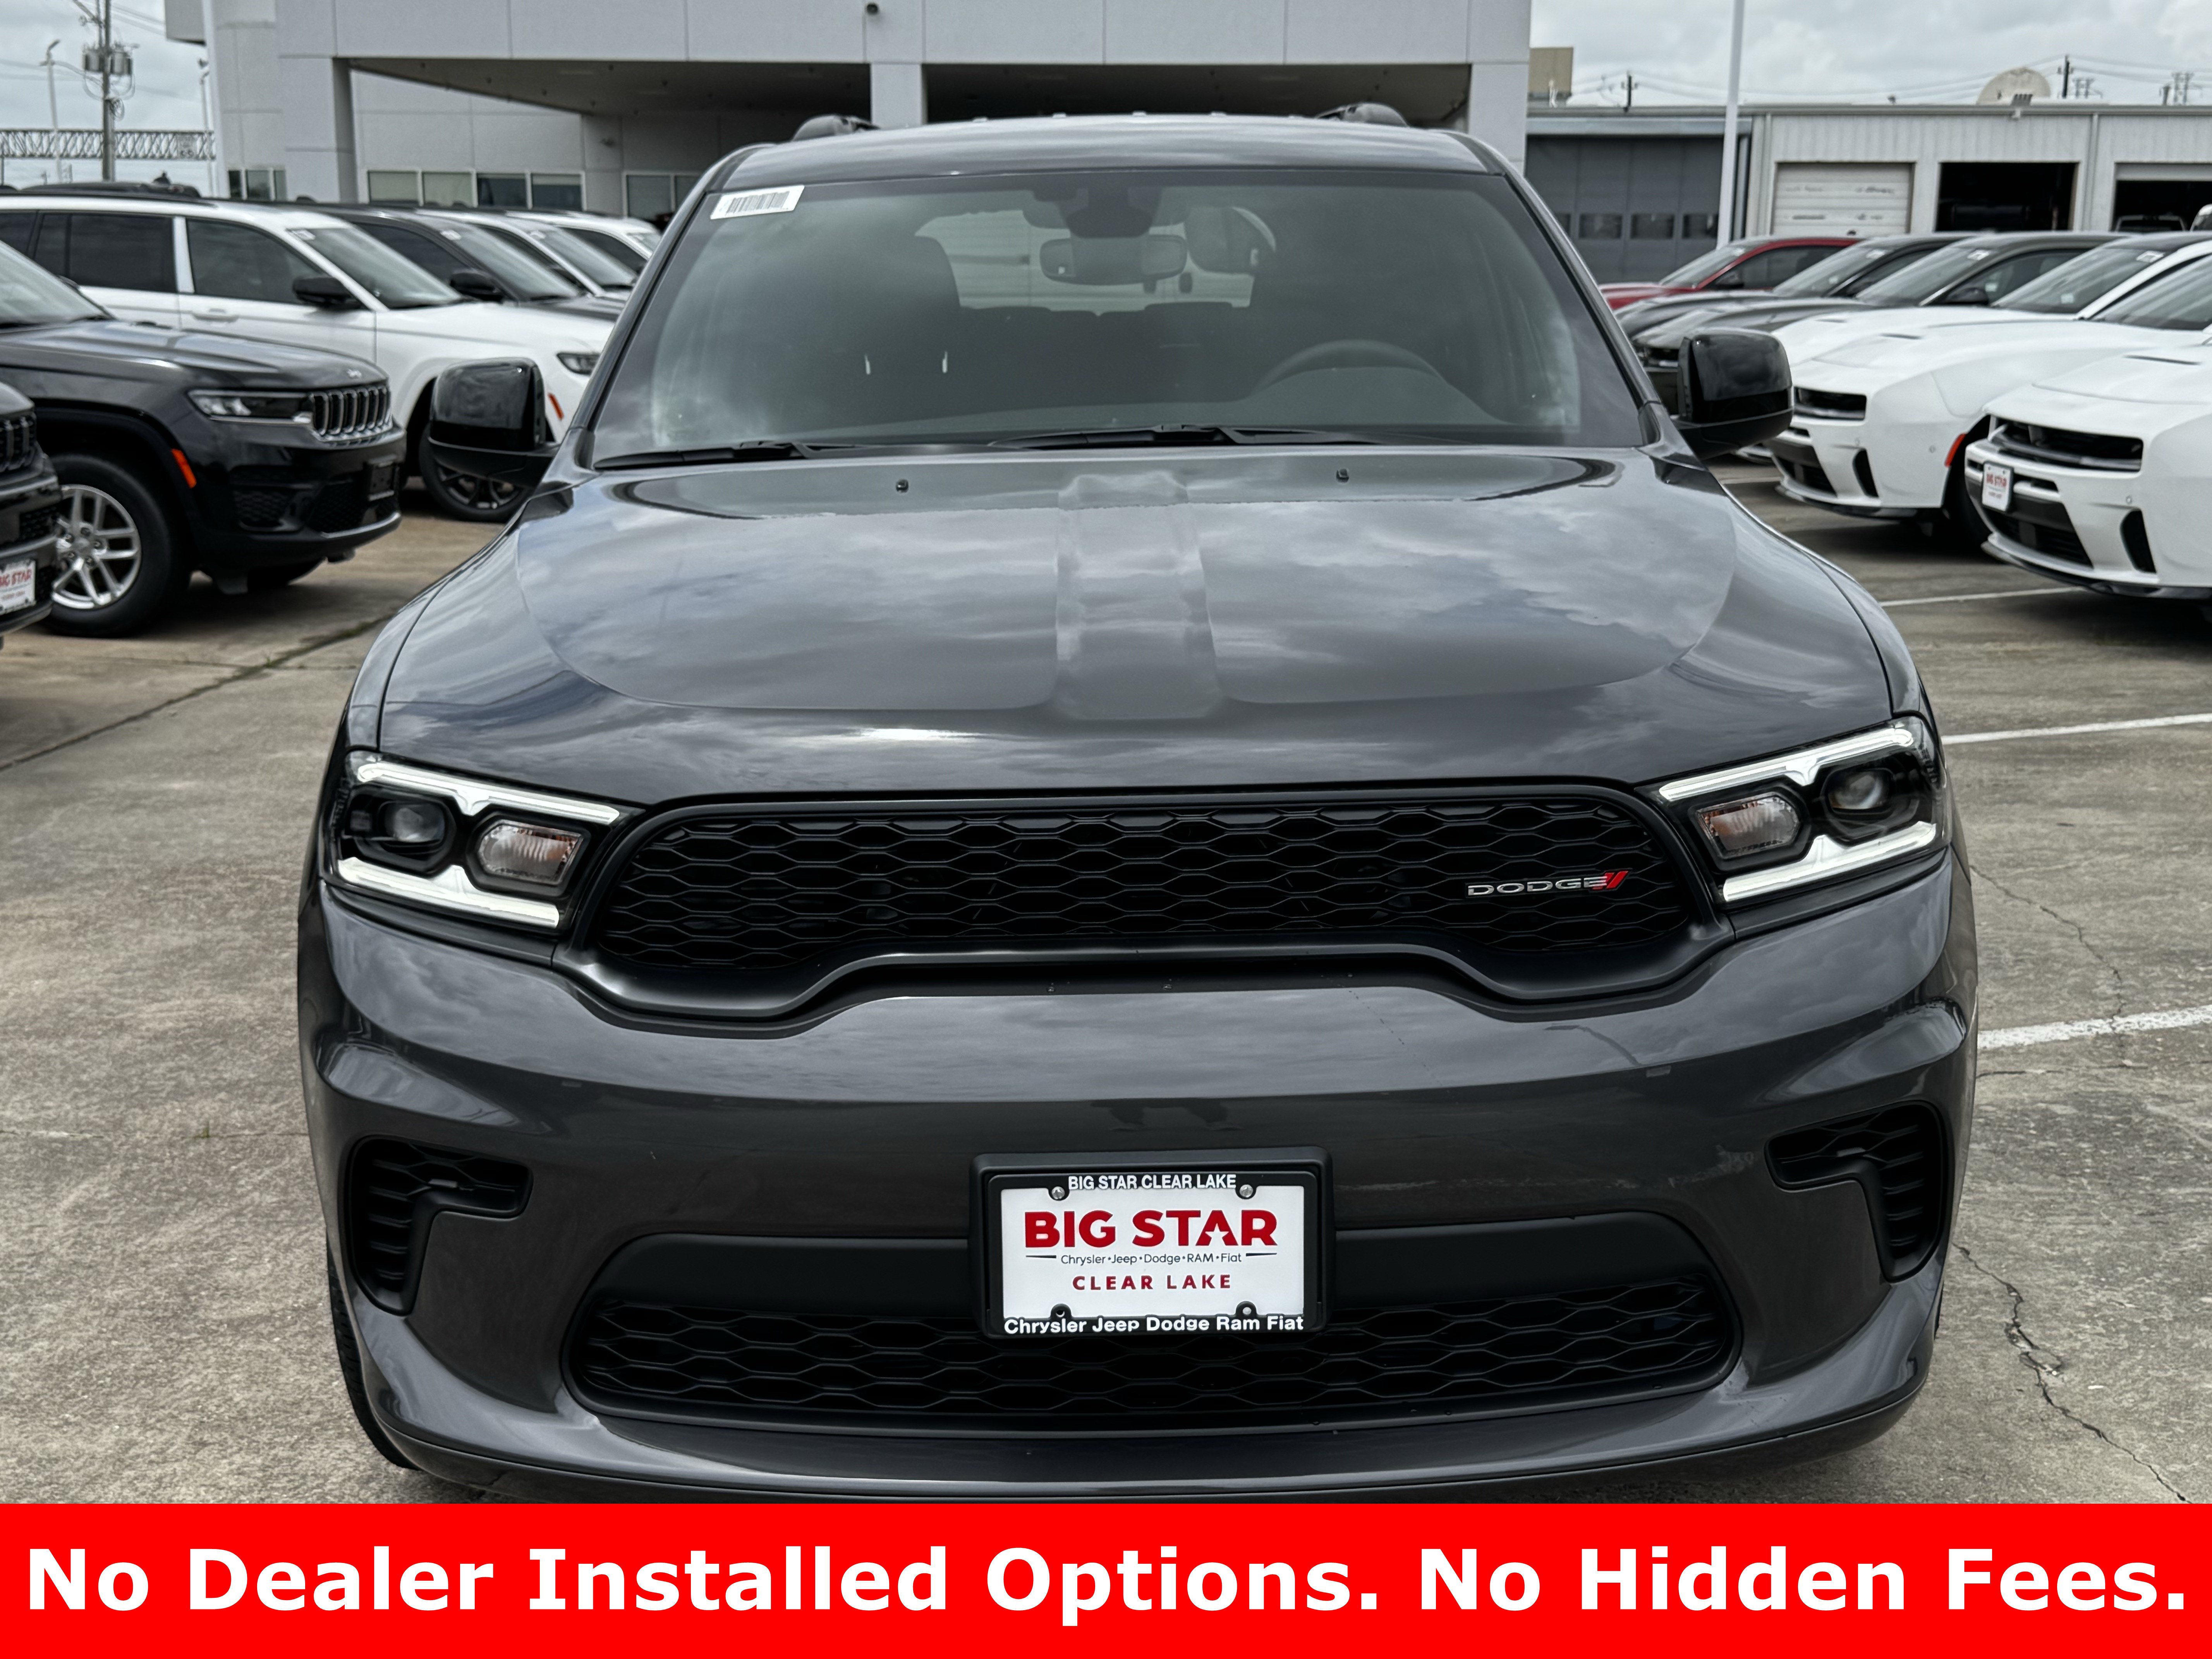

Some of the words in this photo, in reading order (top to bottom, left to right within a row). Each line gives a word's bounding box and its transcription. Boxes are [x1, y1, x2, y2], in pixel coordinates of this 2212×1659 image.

[1468, 876, 1607, 896] DODGE
[1068, 1176, 1094, 1190] BIG
[1098, 1175, 1137, 1189] STAR
[1141, 1175, 1192, 1189] CLEAR
[1197, 1174, 1236, 1188] LAKE
[1025, 1210, 1116, 1248] BIG
[1132, 1209, 1278, 1247] STAR
[1061, 1255, 1106, 1266] Chrysler
[1111, 1254, 1137, 1265] Jeep
[1144, 1254, 1180, 1265] Dodge
[1187, 1253, 1214, 1262] RAM
[1221, 1253, 1242, 1262] Fiat
[1072, 1275, 1153, 1290] CLEAR
[1167, 1274, 1230, 1289] LAKE
[1004, 1317, 1087, 1334] Chrysler
[1092, 1317, 1140, 1333] Jeep
[1146, 1316, 1209, 1332] Dodge
[1216, 1316, 1260, 1331] Ram
[1267, 1316, 1304, 1331] Fiat
